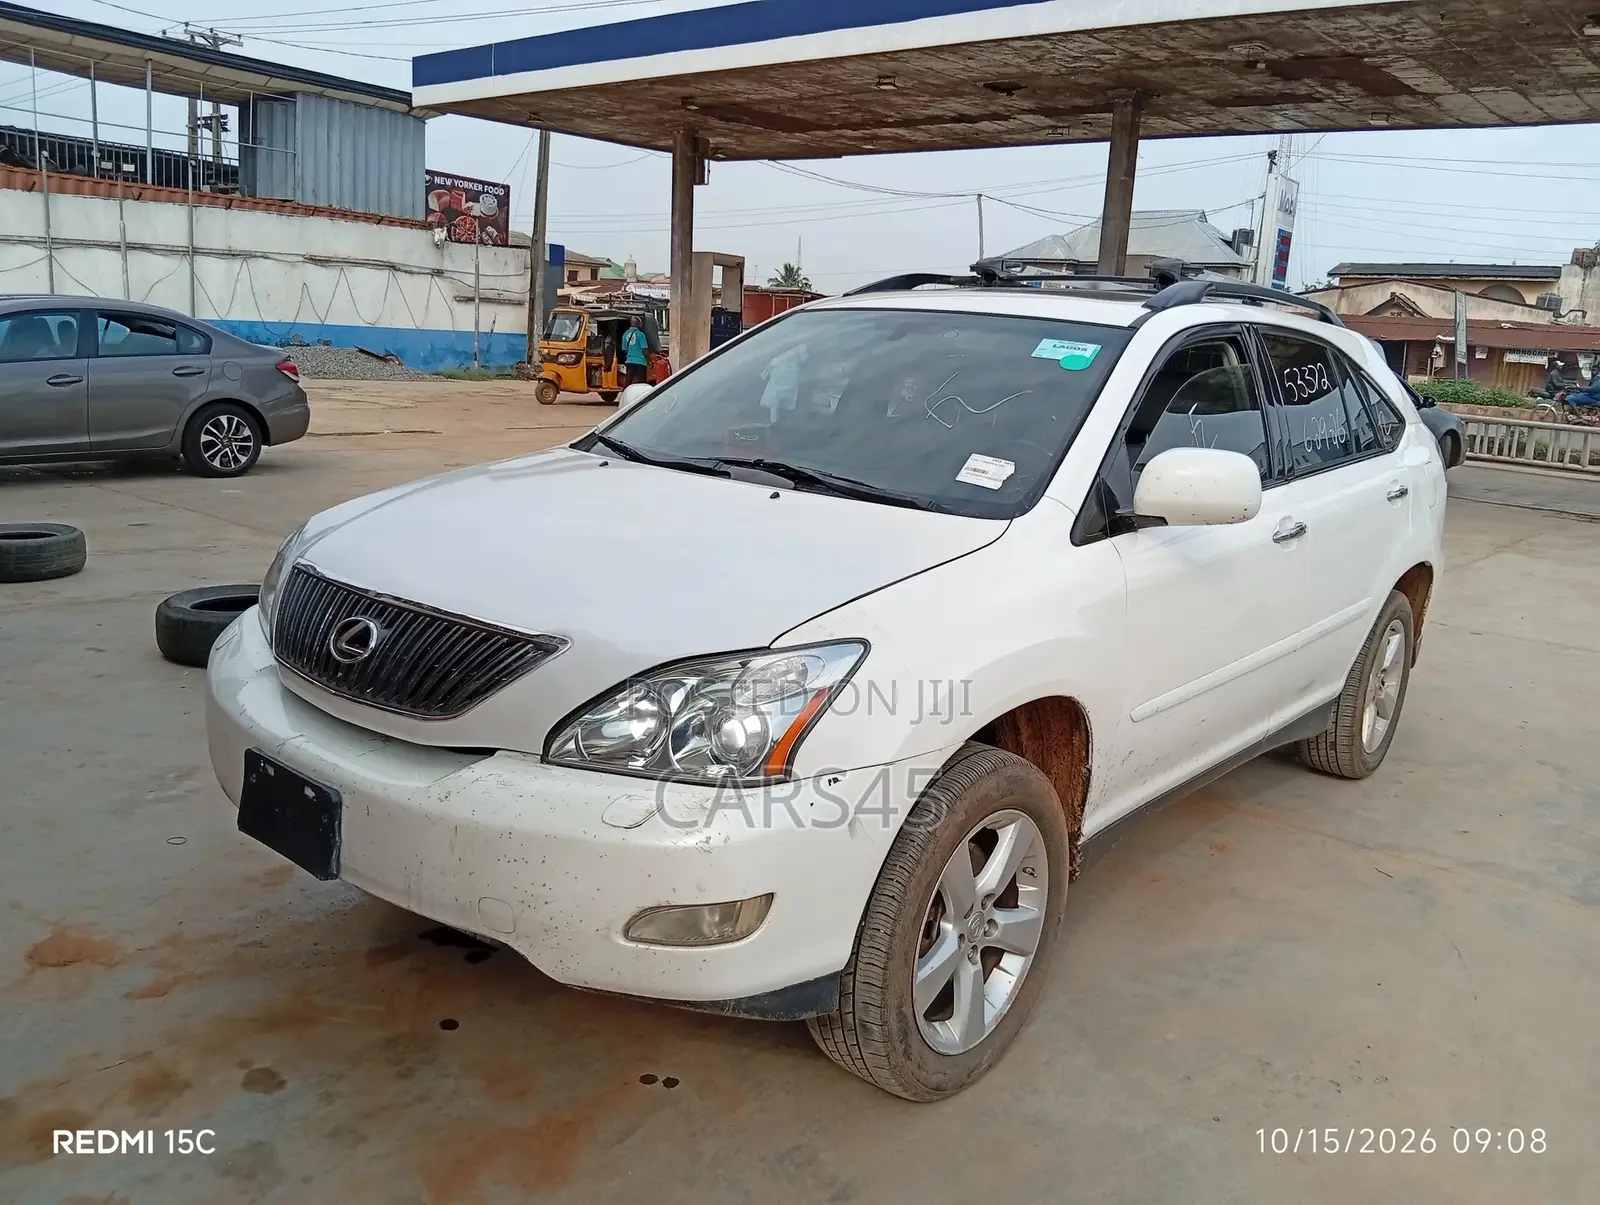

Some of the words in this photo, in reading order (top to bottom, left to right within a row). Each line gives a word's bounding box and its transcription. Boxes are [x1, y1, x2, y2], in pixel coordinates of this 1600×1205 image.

[434, 176, 453, 186] NEW
[453, 179, 483, 191] YORKER
[484, 185, 505, 196] FOOD
[1052, 343, 1088, 352] LAGOS
[1508, 348, 1556, 357] MONOGRAM
